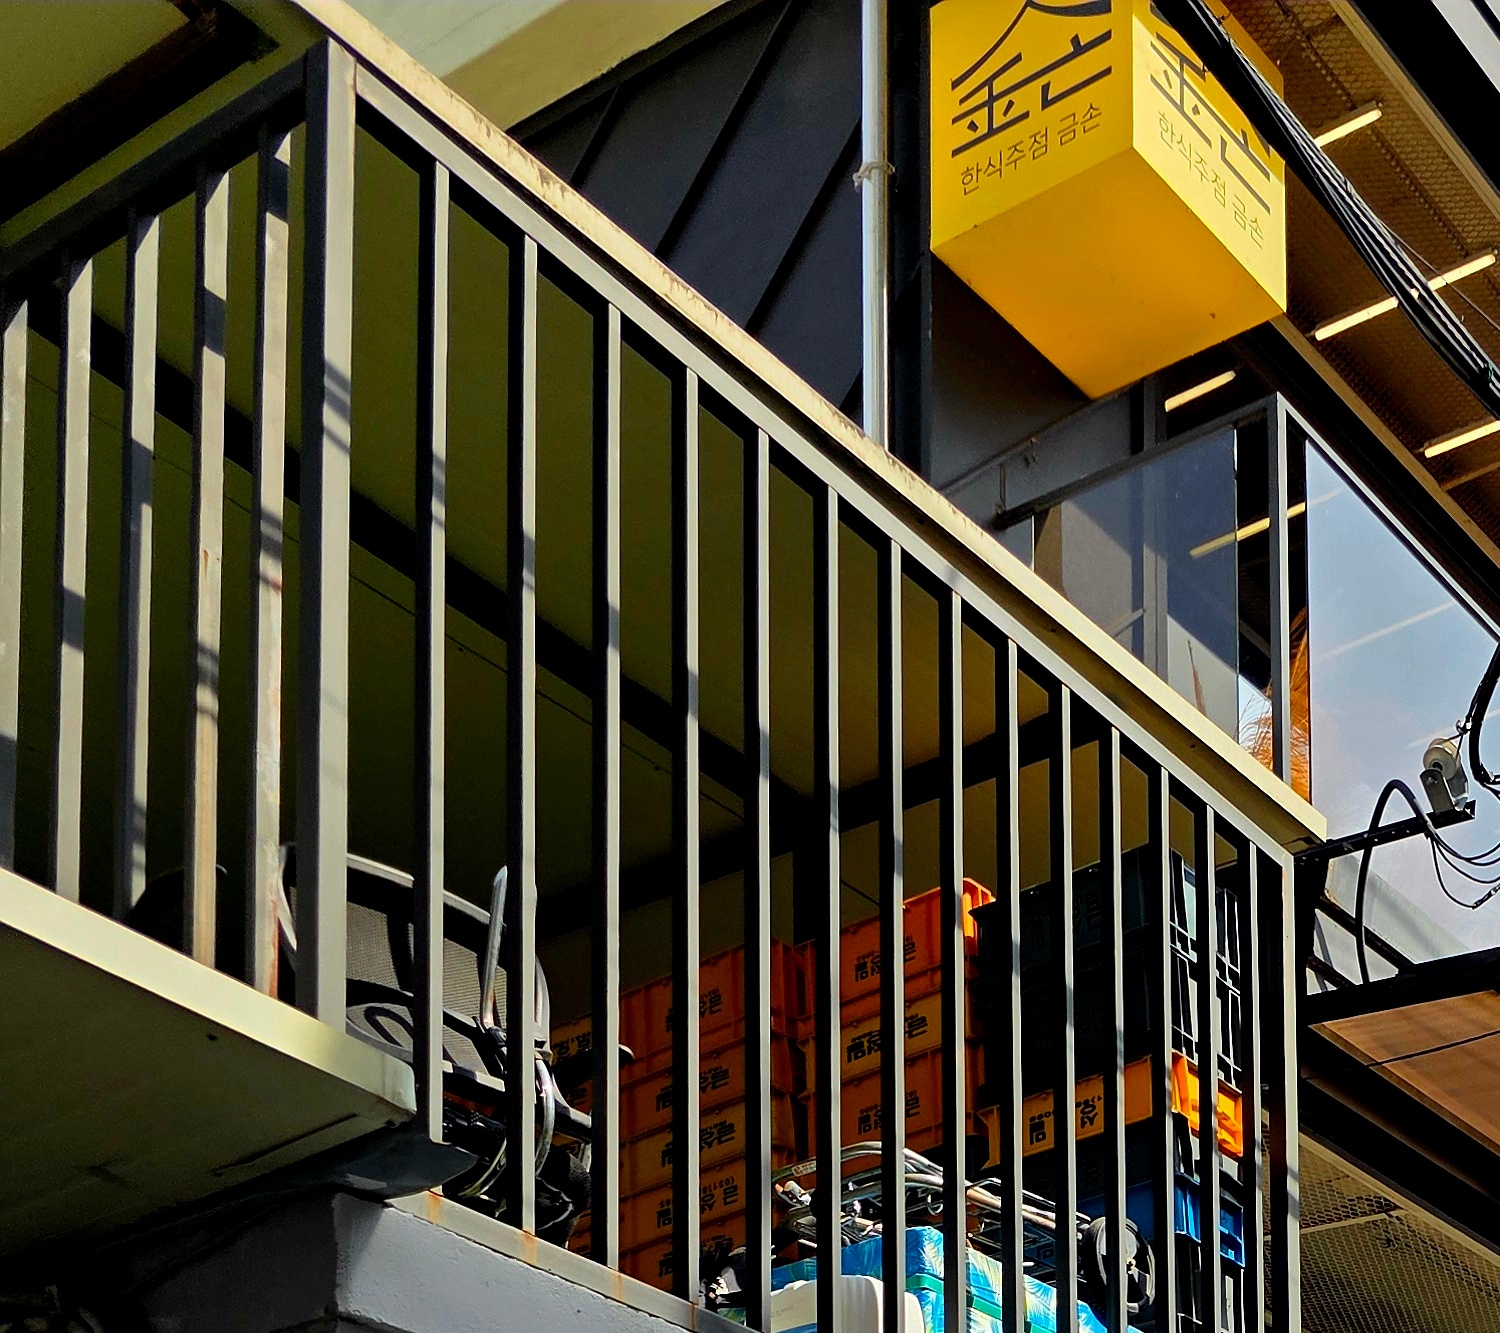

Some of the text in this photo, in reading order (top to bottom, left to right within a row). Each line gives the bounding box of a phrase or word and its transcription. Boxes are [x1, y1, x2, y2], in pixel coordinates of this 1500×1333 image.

[960, 102, 1102, 196] 한식주점 금손
[1158, 110, 1264, 250] 한식주점 금손
